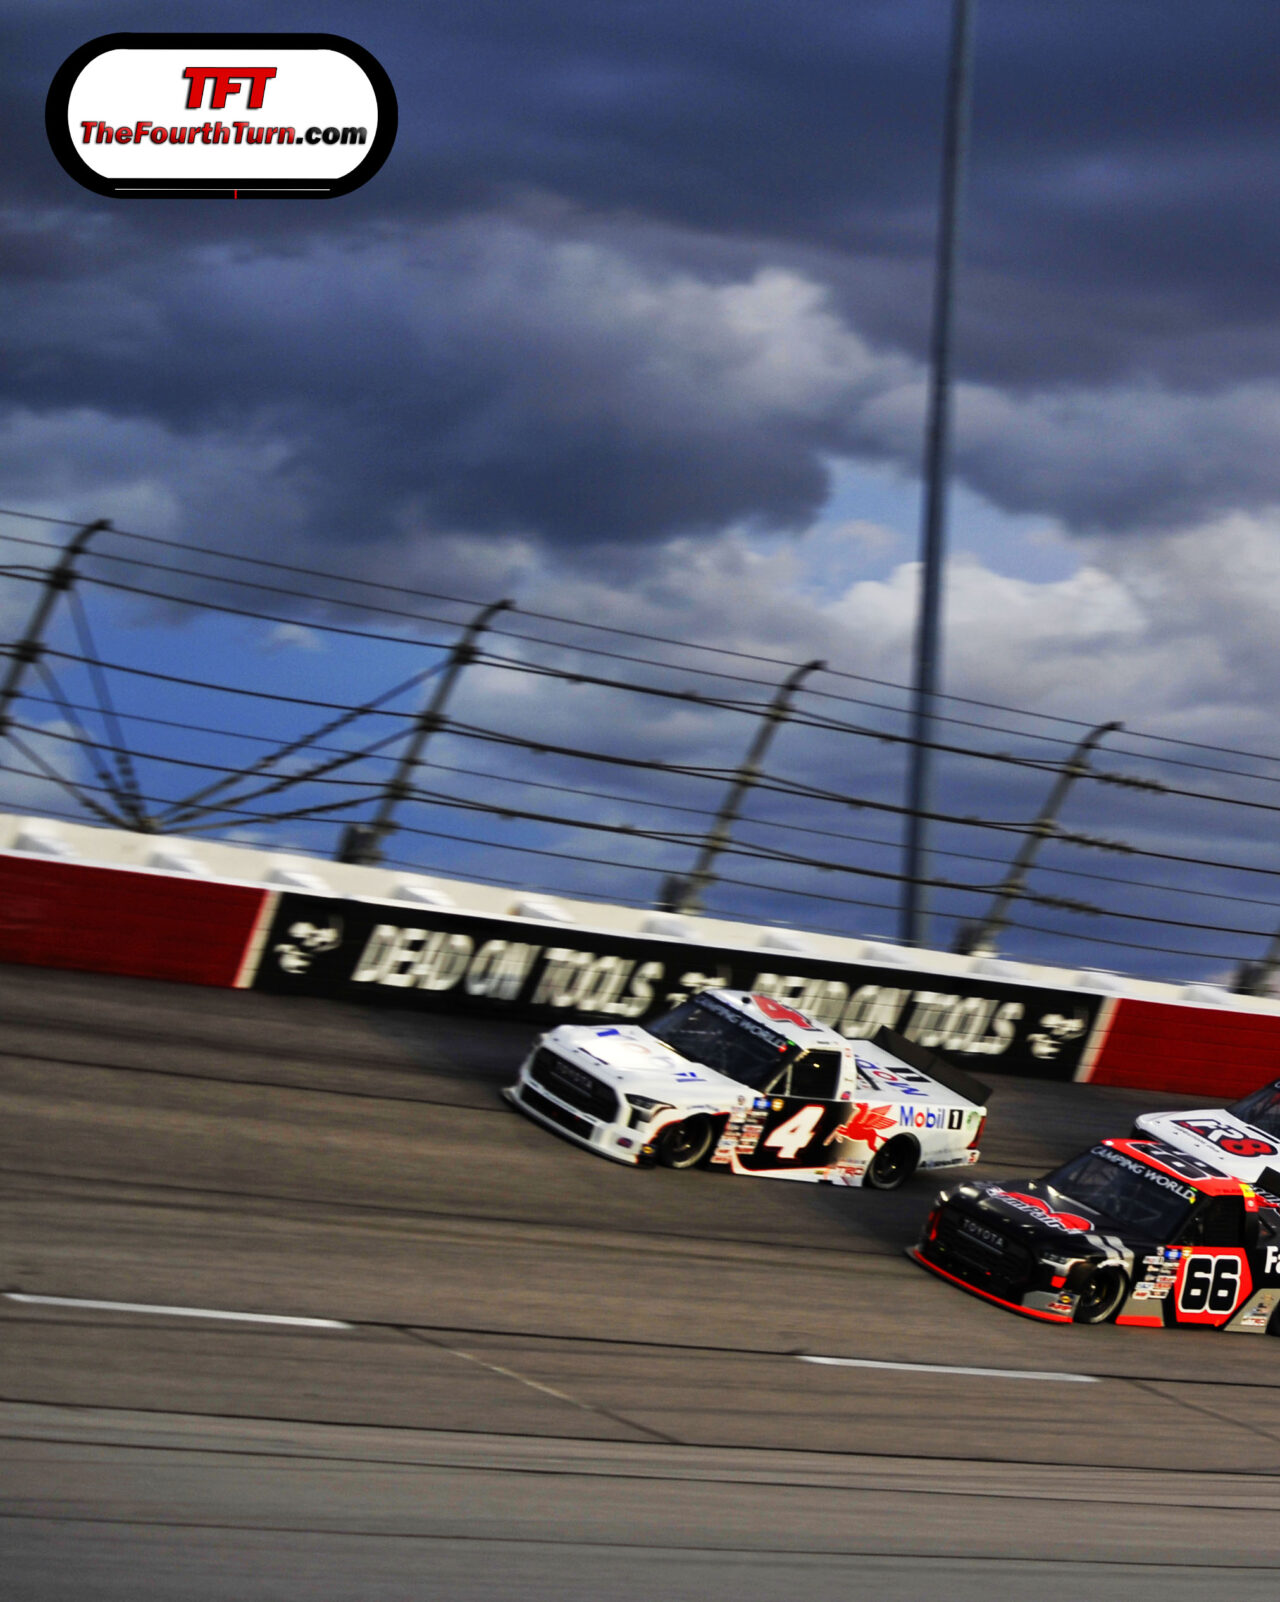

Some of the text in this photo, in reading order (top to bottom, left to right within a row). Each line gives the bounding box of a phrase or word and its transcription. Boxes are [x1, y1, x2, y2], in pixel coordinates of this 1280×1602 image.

[351, 924, 664, 1017] DEAD ON TOOLS
[751, 993, 824, 1032] 4
[903, 990, 1025, 1055] TOOLS
[763, 1104, 826, 1158] 4
[900, 1105, 964, 1130] Mobil 1
[1090, 1146, 1196, 1201] CAMPING WORLD
[963, 1217, 1005, 1247] TOYOTA
[1178, 1254, 1242, 1315] 66
